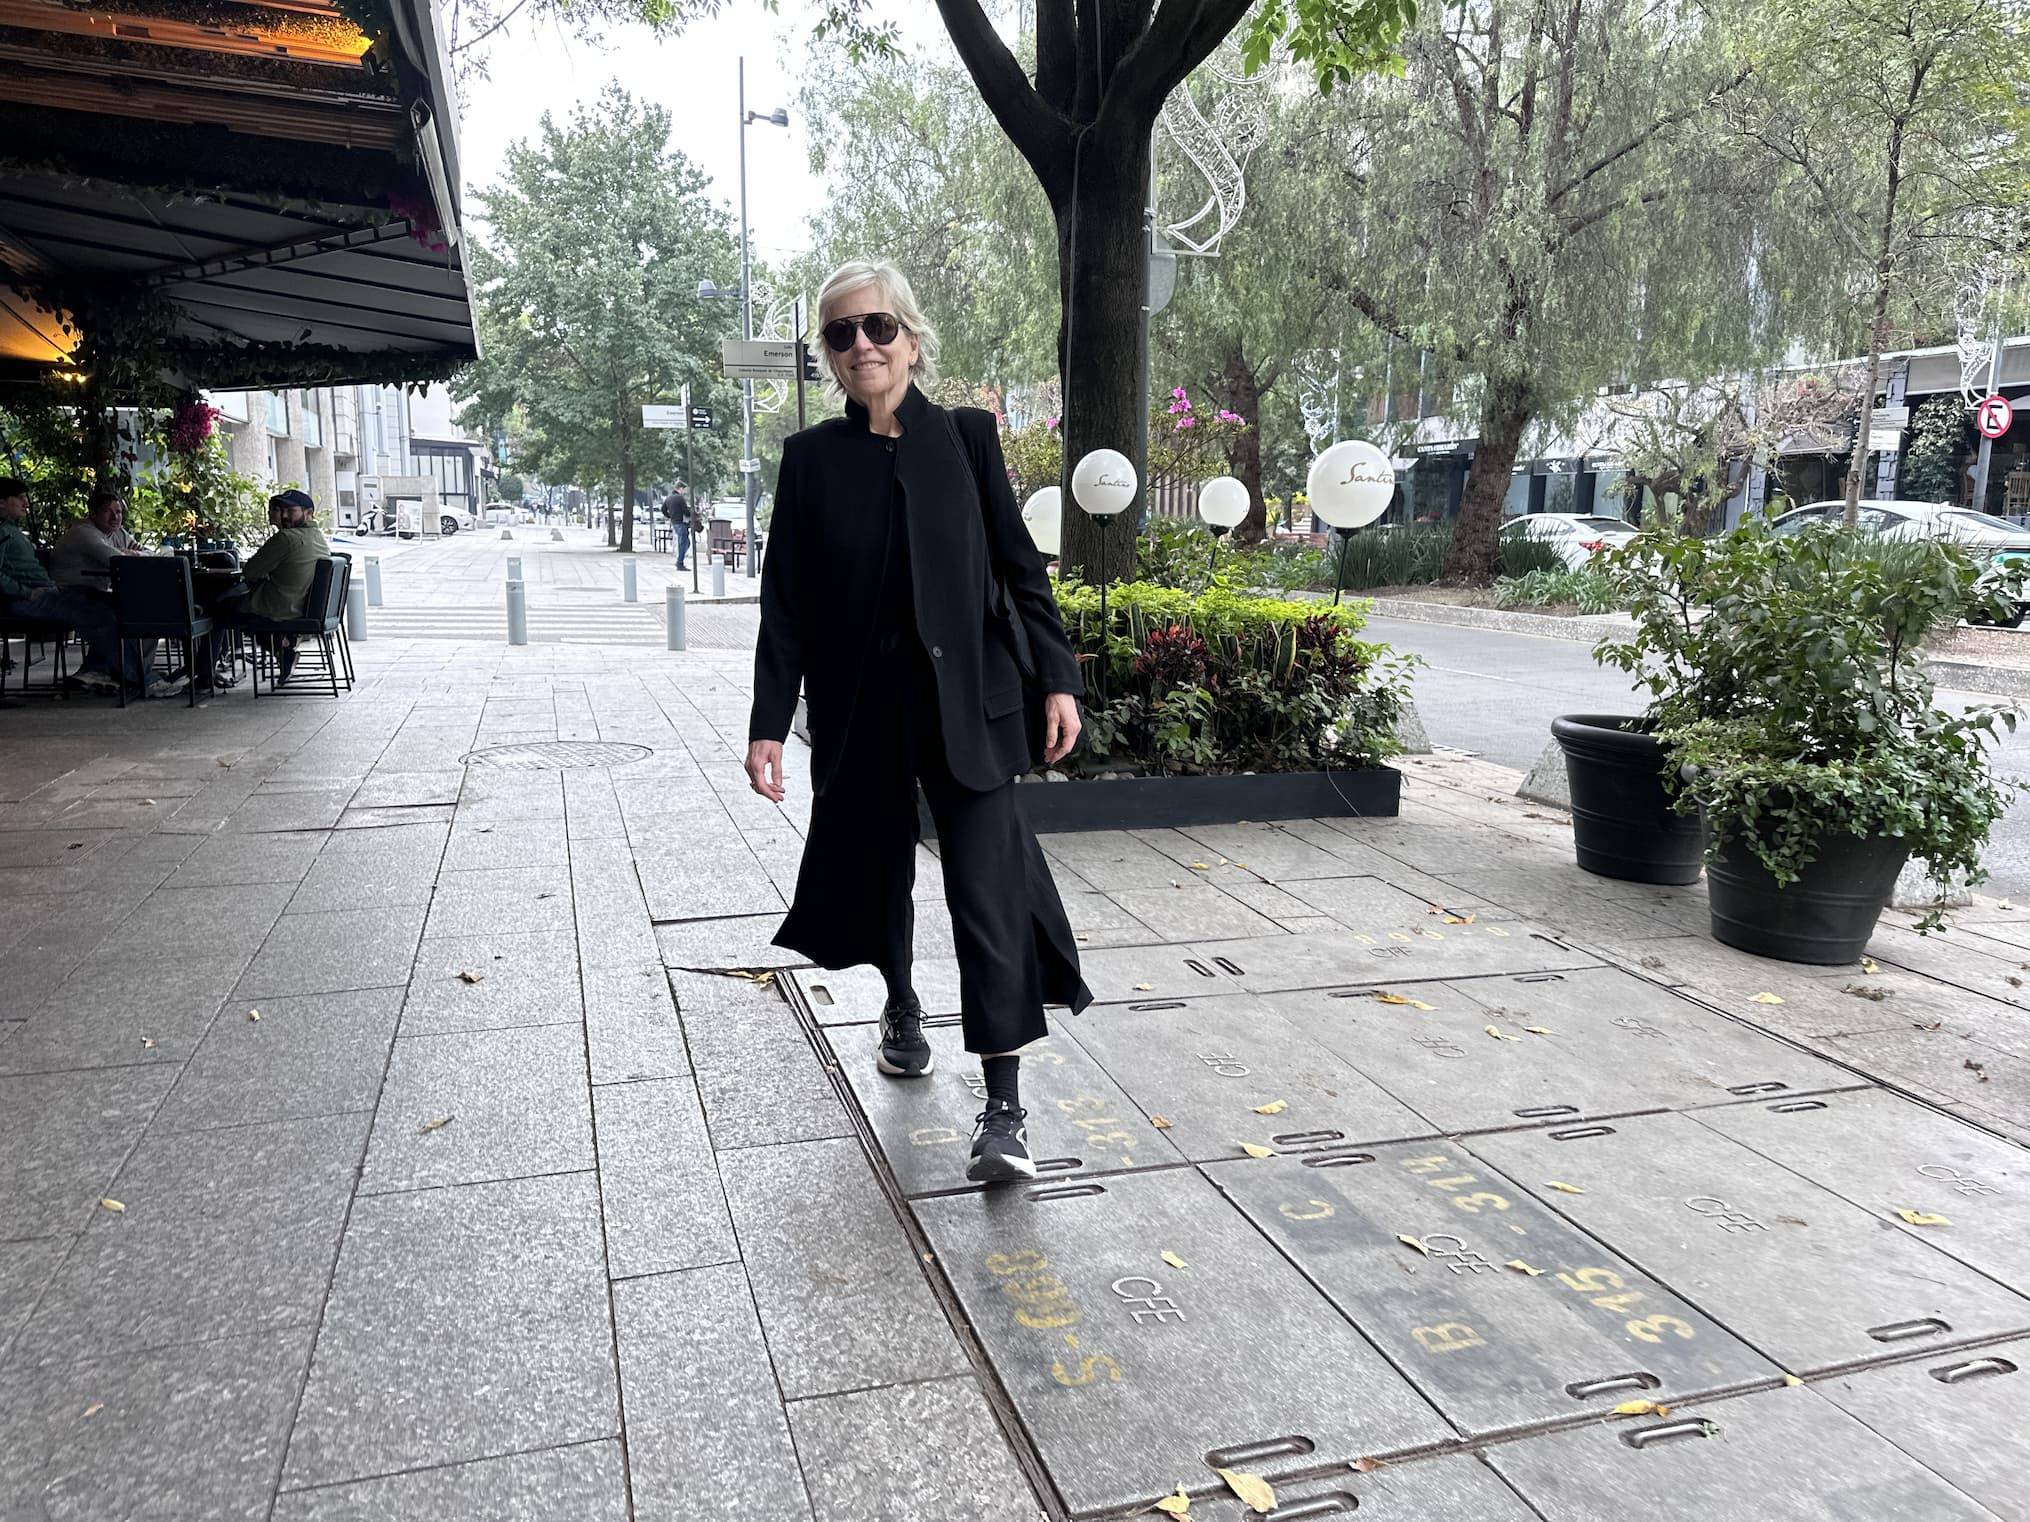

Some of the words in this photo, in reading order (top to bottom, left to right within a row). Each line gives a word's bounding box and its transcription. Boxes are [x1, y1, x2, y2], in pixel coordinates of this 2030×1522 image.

[763, 350, 793, 358] Emerson
[1195, 1051, 1251, 1078] CFE
[1915, 1163, 2003, 1196] CFE
[1278, 1199, 1336, 1221] C
[1684, 1196, 1770, 1234] CFE
[1420, 1232, 1501, 1276] CFE
[1110, 1275, 1188, 1325] CFE
[1410, 1321, 1489, 1354] B
